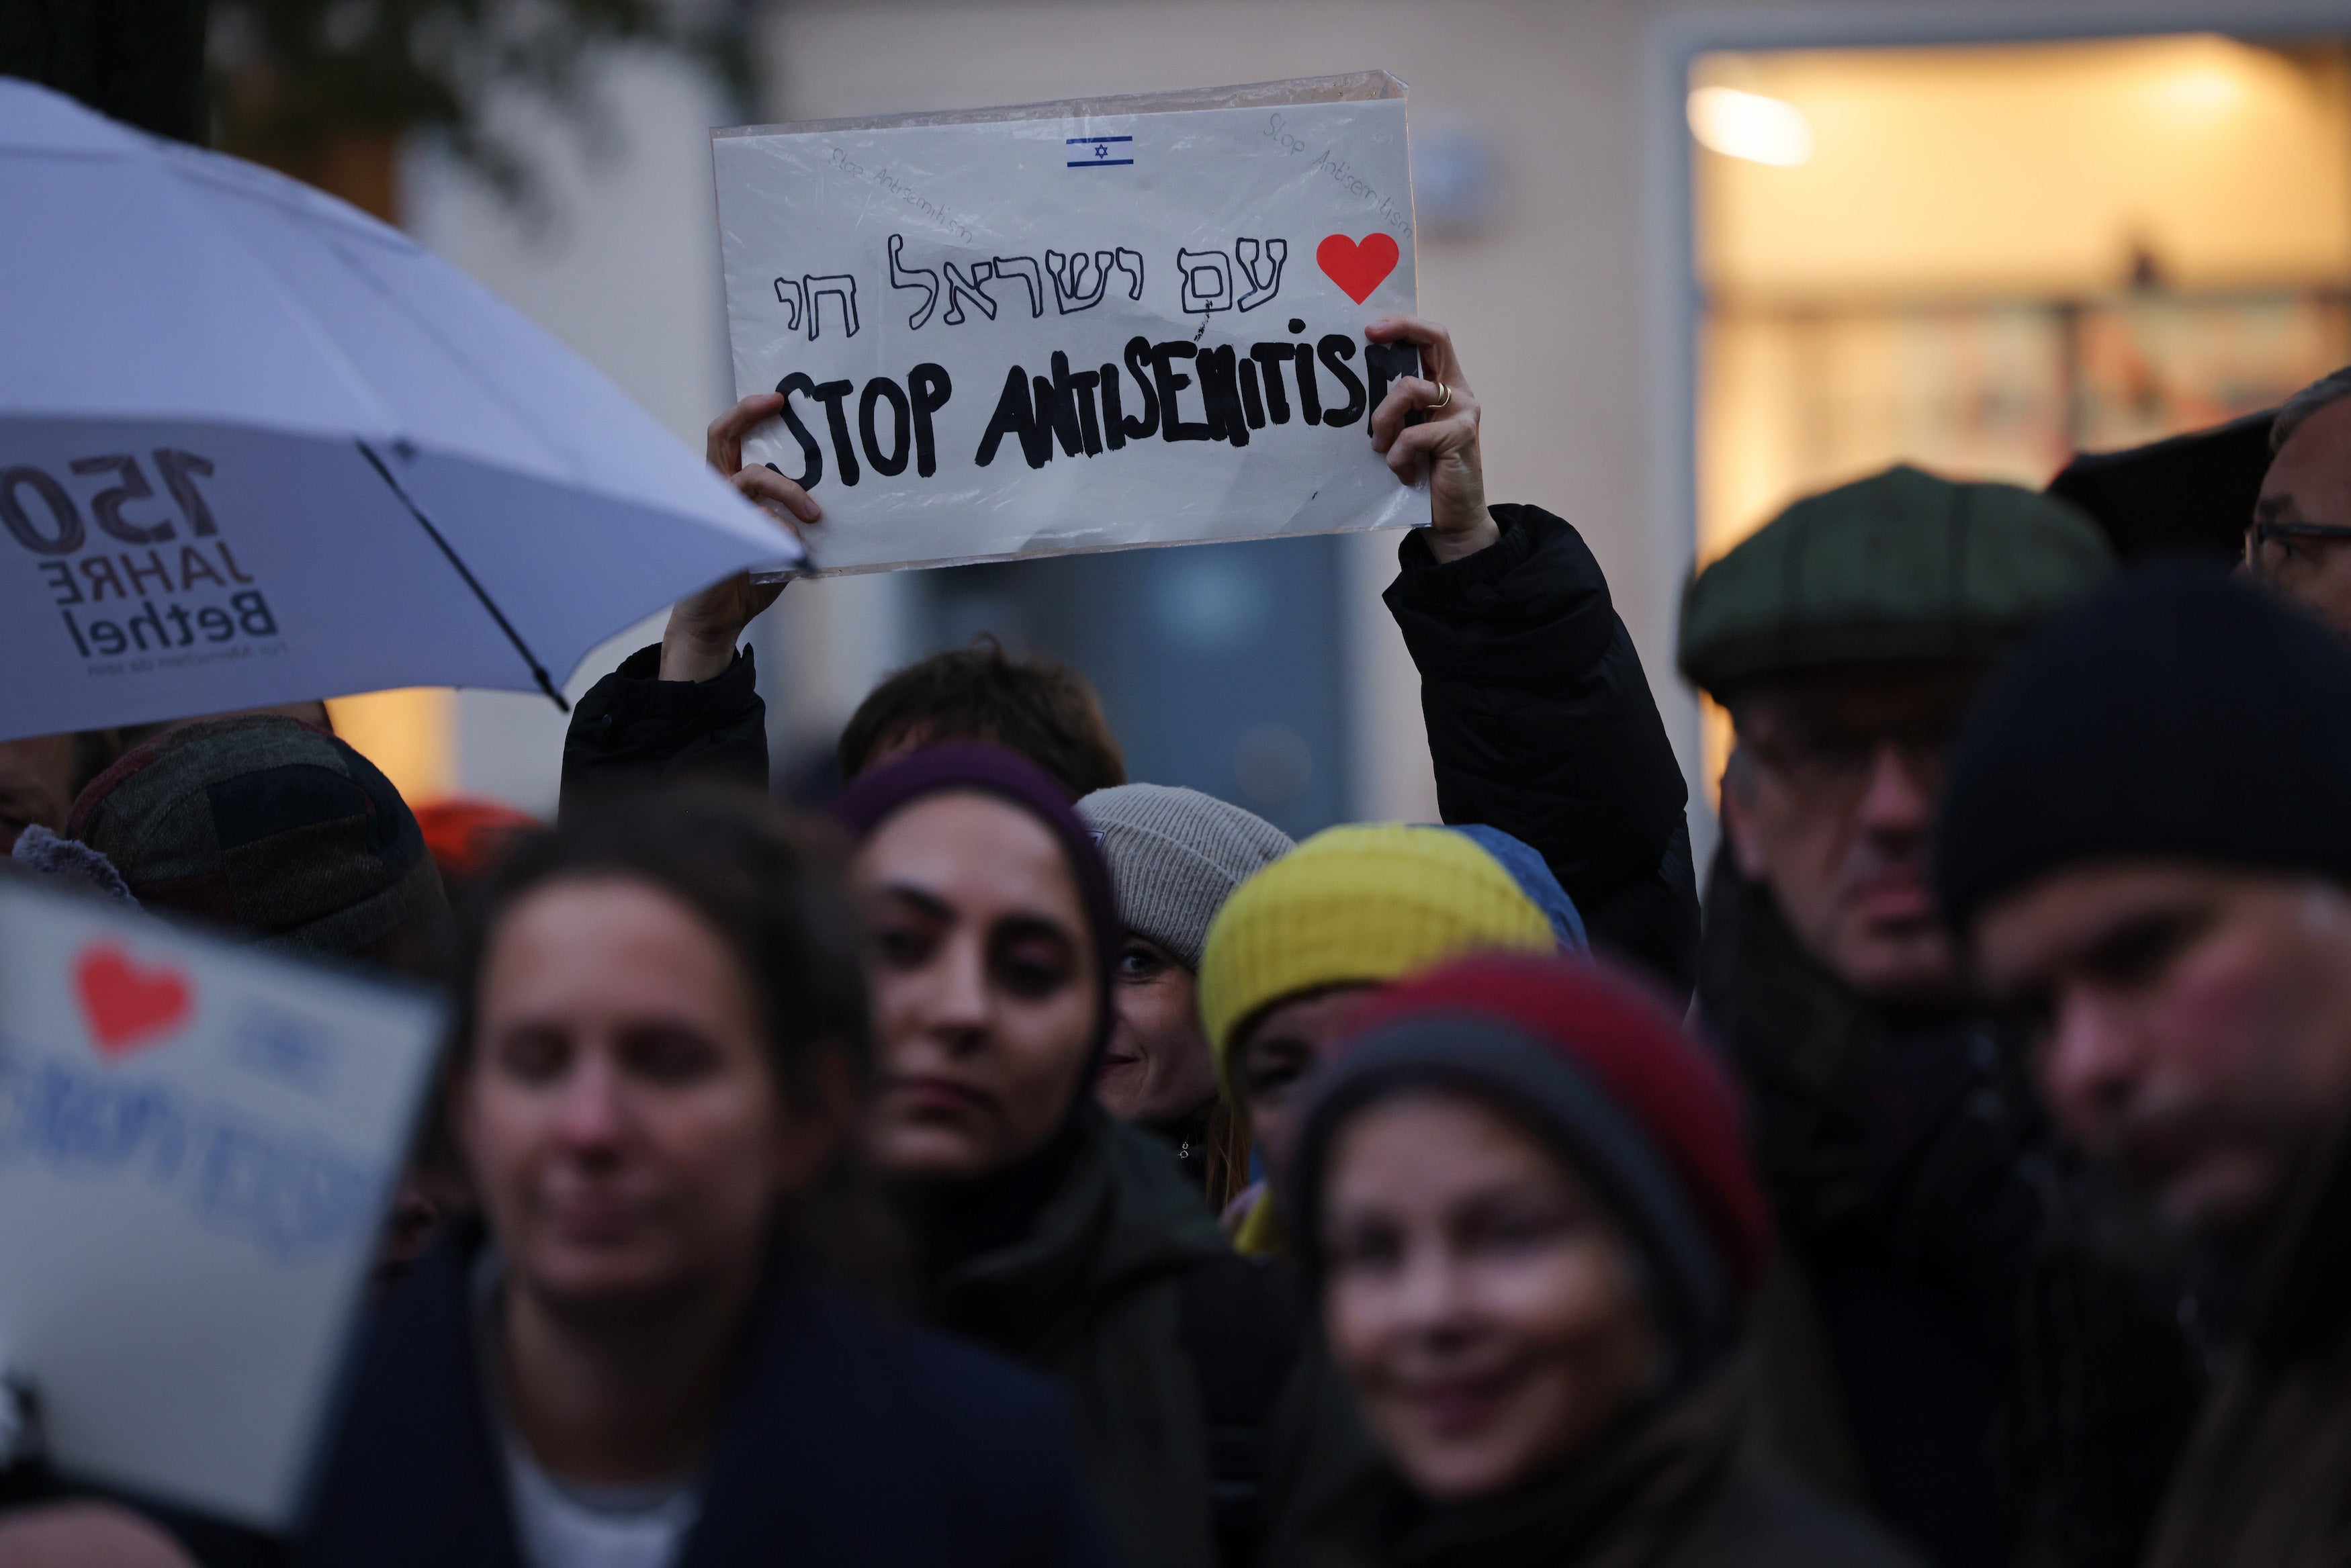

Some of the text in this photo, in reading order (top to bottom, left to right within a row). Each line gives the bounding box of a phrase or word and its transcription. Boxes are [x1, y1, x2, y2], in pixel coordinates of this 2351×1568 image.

[828, 148, 864, 177] Stop
[1260, 112, 1413, 239] Stop Antisemitism
[774, 234, 1288, 341] עם ישראל חי
[765, 363, 952, 492] STOP
